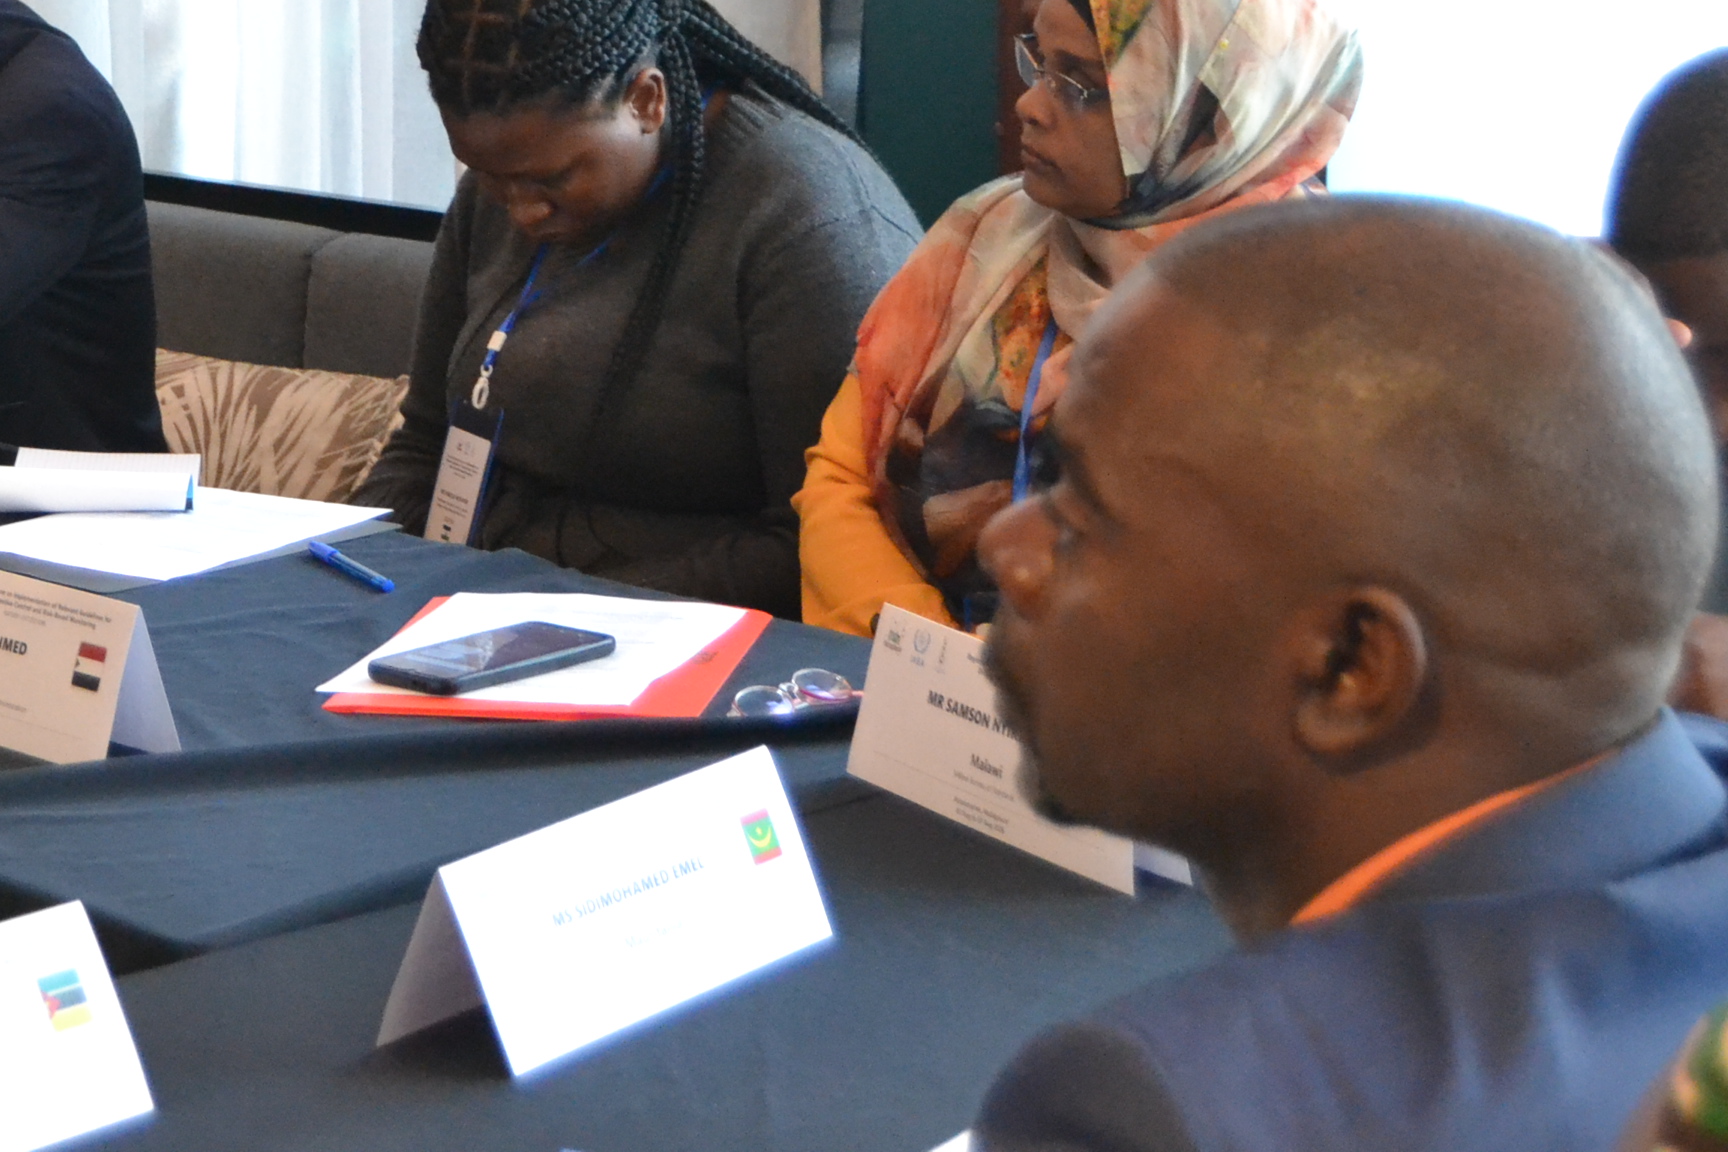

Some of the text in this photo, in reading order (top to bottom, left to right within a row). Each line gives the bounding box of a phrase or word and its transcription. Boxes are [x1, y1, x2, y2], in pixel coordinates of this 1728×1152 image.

[927, 689, 945, 711] MR
[945, 697, 991, 729] SAMSON
[971, 752, 1004, 780] Malawi
[552, 908, 574, 928] MS
[574, 868, 670, 920] SIDIMOHAMED
